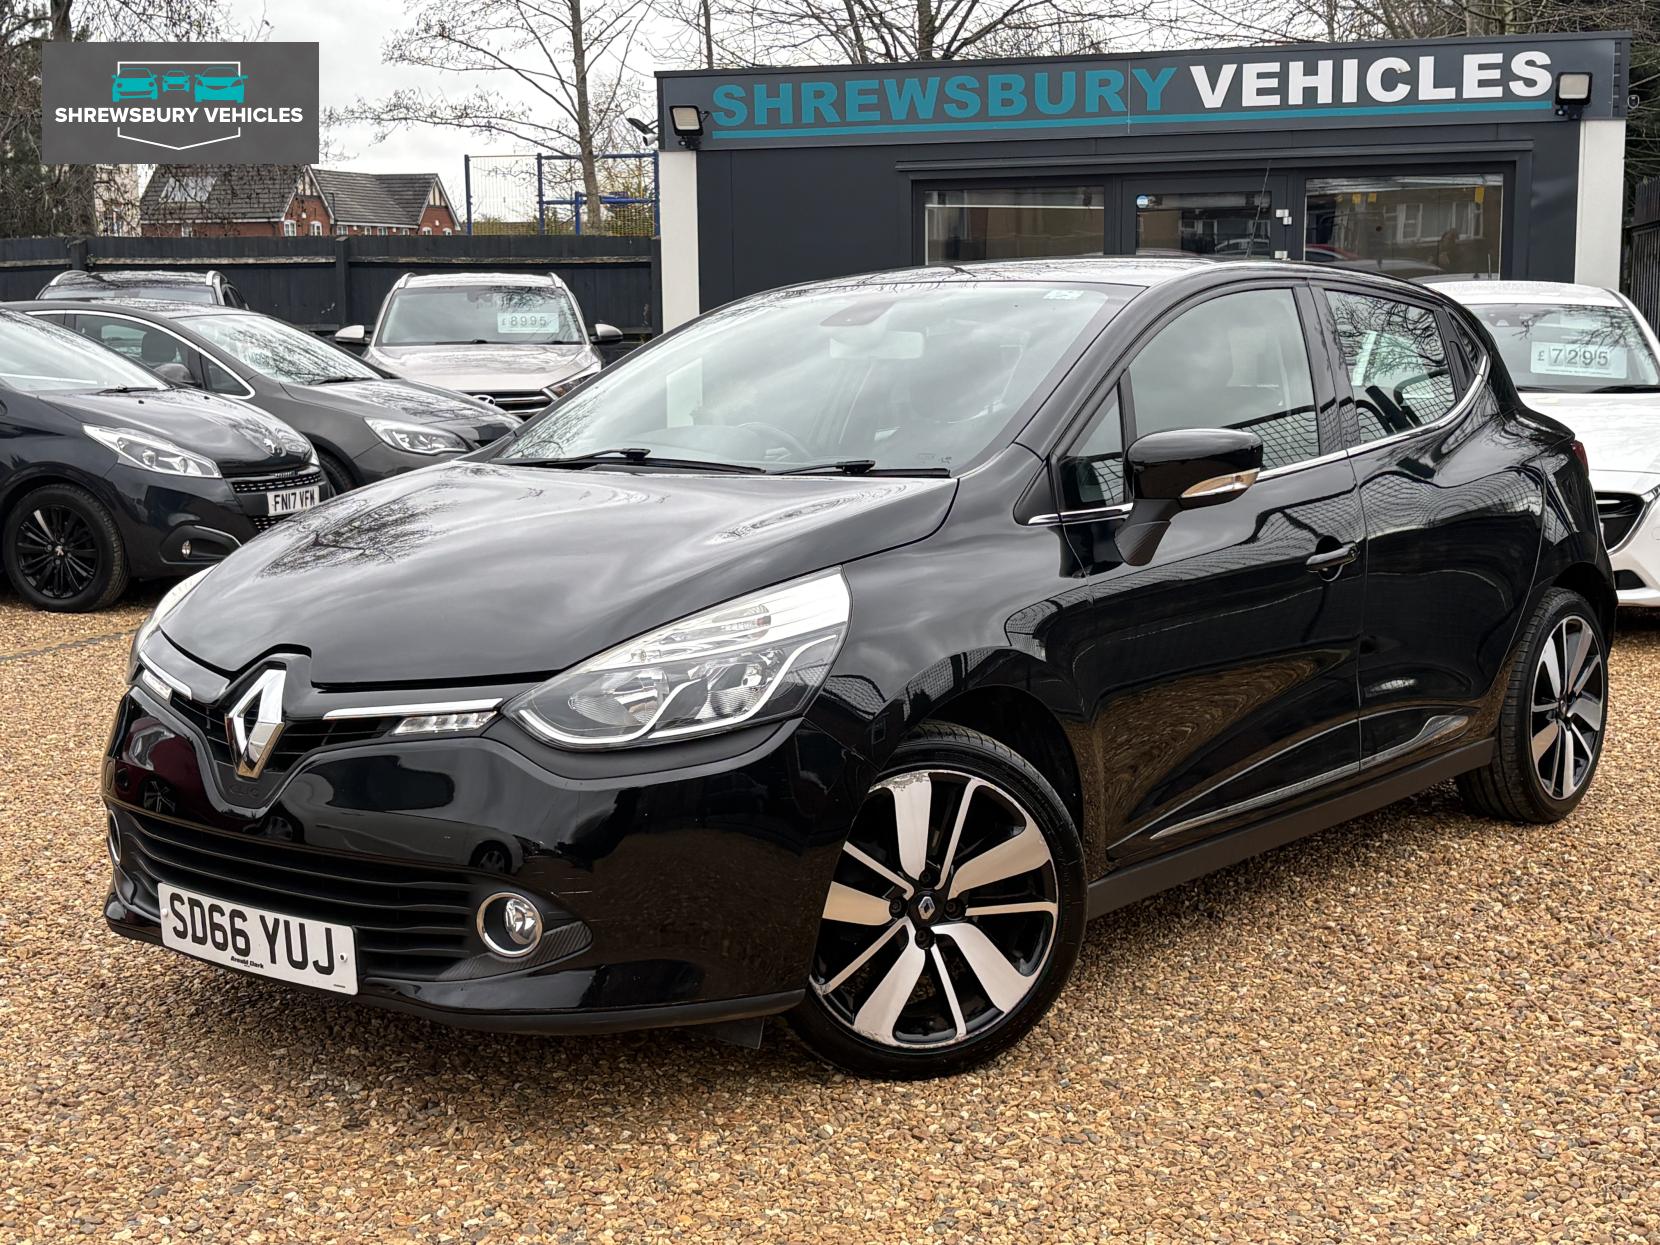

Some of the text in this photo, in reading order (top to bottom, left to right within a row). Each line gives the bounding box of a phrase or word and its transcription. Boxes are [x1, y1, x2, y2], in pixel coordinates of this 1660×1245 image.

[711, 50, 1553, 127] SHREWSBURY VEHICLES
[1537, 348, 1609, 367] £7295
[273, 492, 297, 512] FN17
[169, 892, 335, 976] SD66 YUJ
